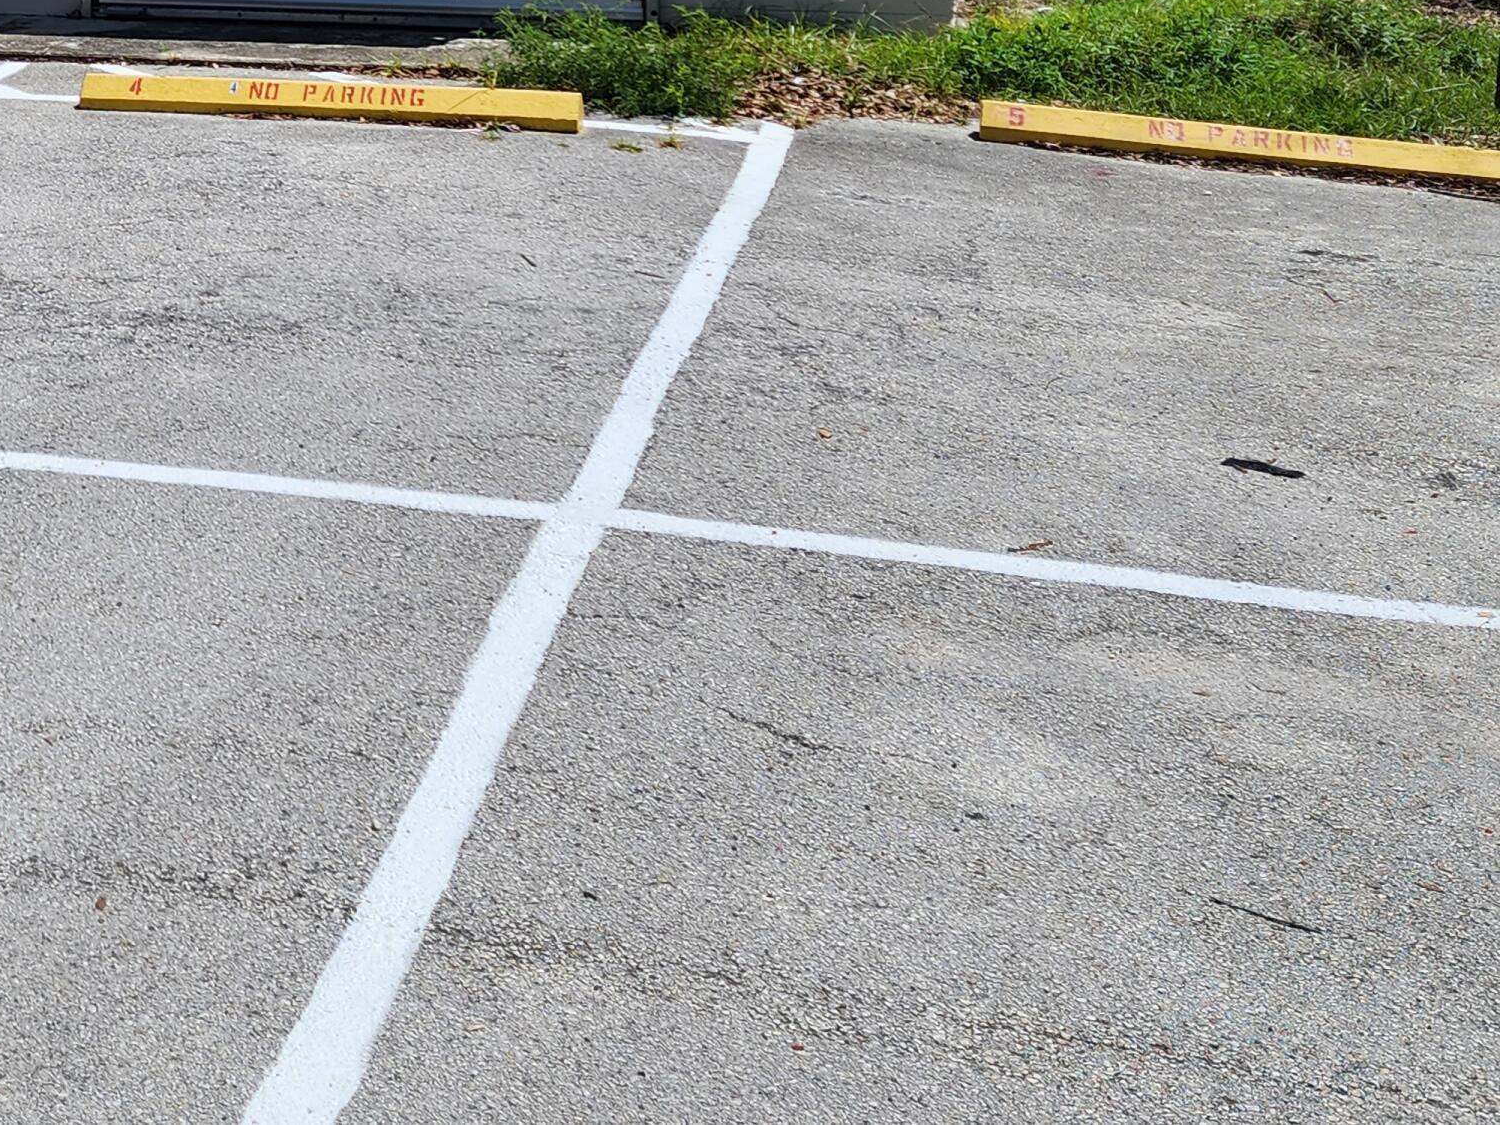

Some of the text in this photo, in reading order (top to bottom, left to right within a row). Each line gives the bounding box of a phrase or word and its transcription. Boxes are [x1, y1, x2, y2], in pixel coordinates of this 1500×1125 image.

[129, 78, 237, 95] 4 4
[249, 82, 425, 106] NO PARKING
[1009, 107, 1025, 126] 5
[1148, 120, 1354, 157] NO PARKING
